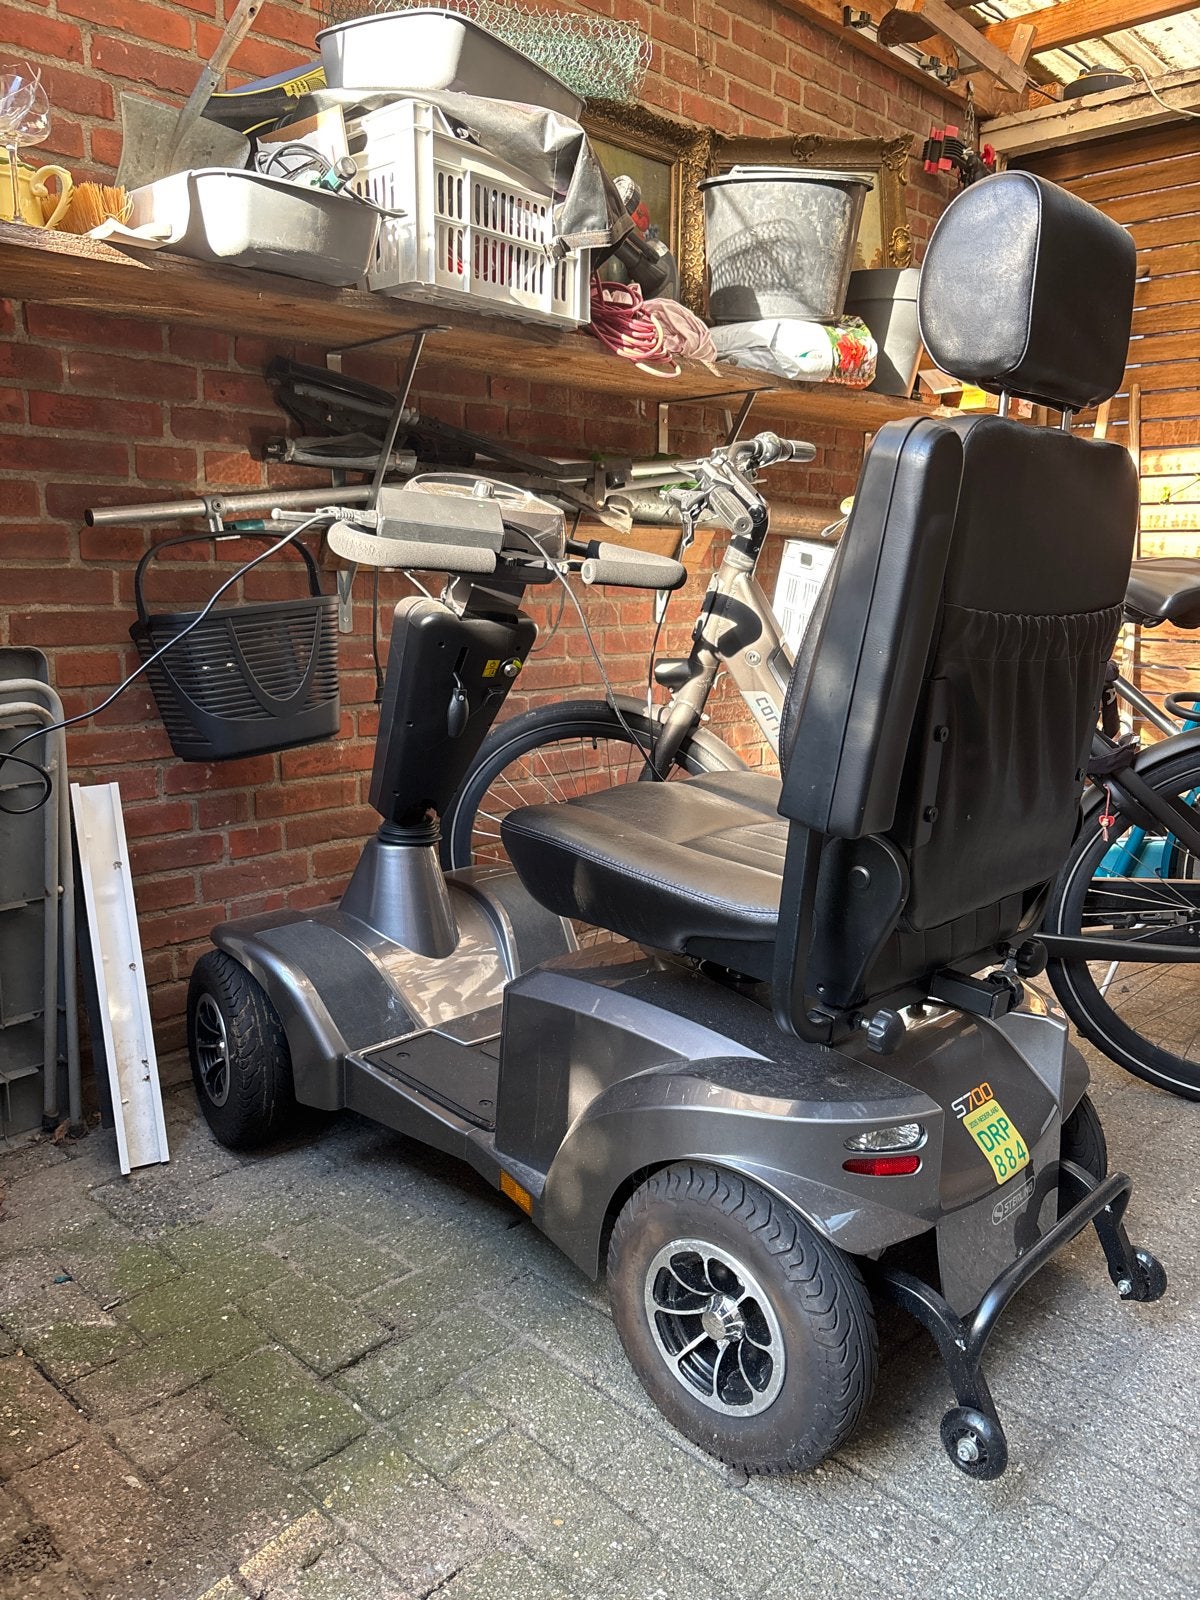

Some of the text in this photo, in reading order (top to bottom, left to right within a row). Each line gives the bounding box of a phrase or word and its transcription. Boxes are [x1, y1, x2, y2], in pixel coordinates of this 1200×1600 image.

[951, 1082, 994, 1119] S700
[978, 1106, 1000, 1124] NEDERLAND
[977, 1117, 1010, 1152] DRP
[994, 1140, 1027, 1177] 884
[1004, 1182, 1033, 1214] STERLING
